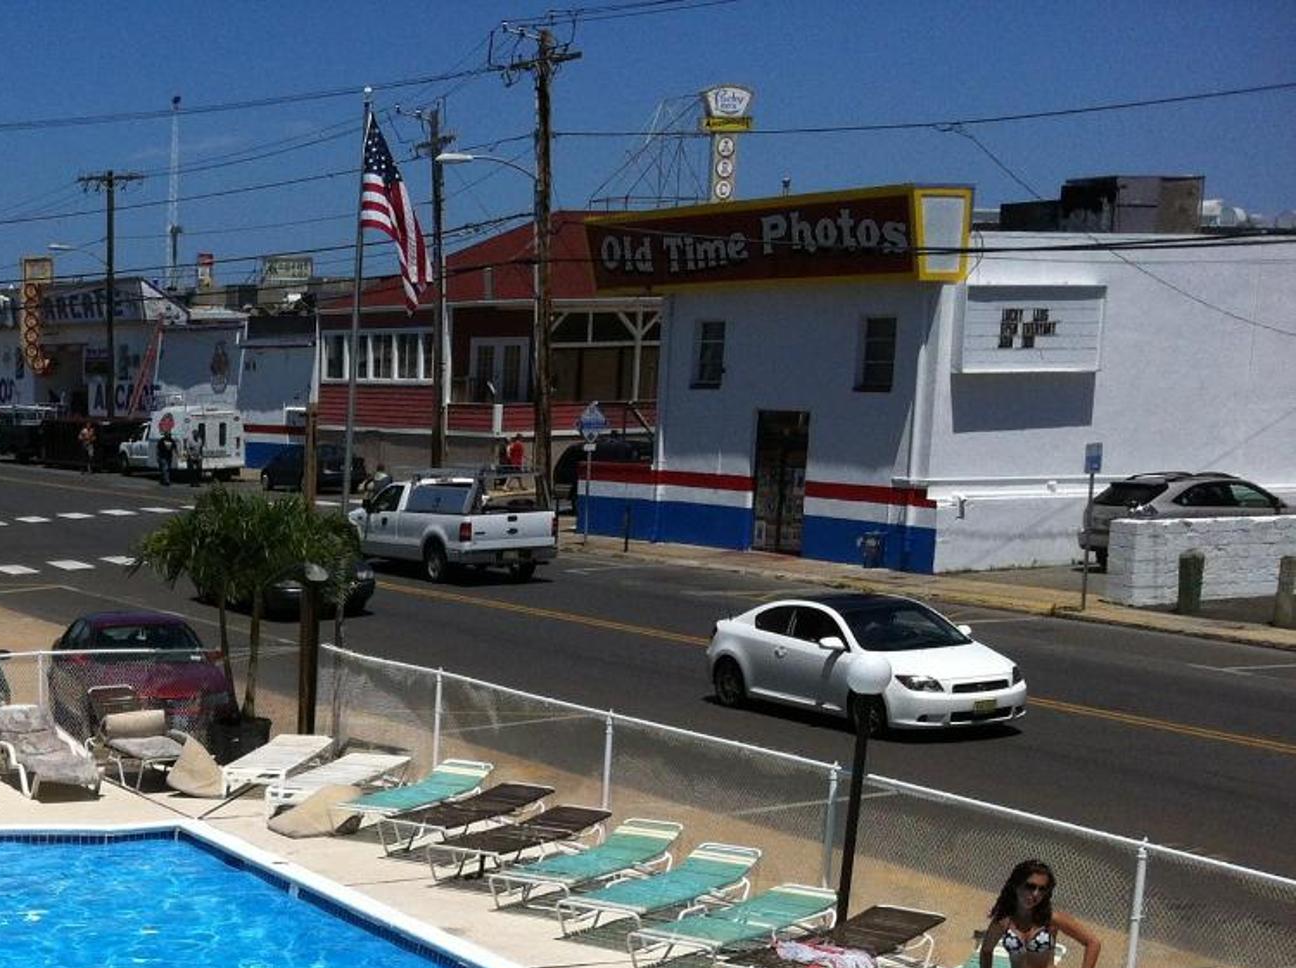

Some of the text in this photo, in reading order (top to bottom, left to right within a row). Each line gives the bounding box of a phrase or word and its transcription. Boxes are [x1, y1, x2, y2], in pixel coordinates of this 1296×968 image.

[600, 209, 907, 273] Old Time Photos
